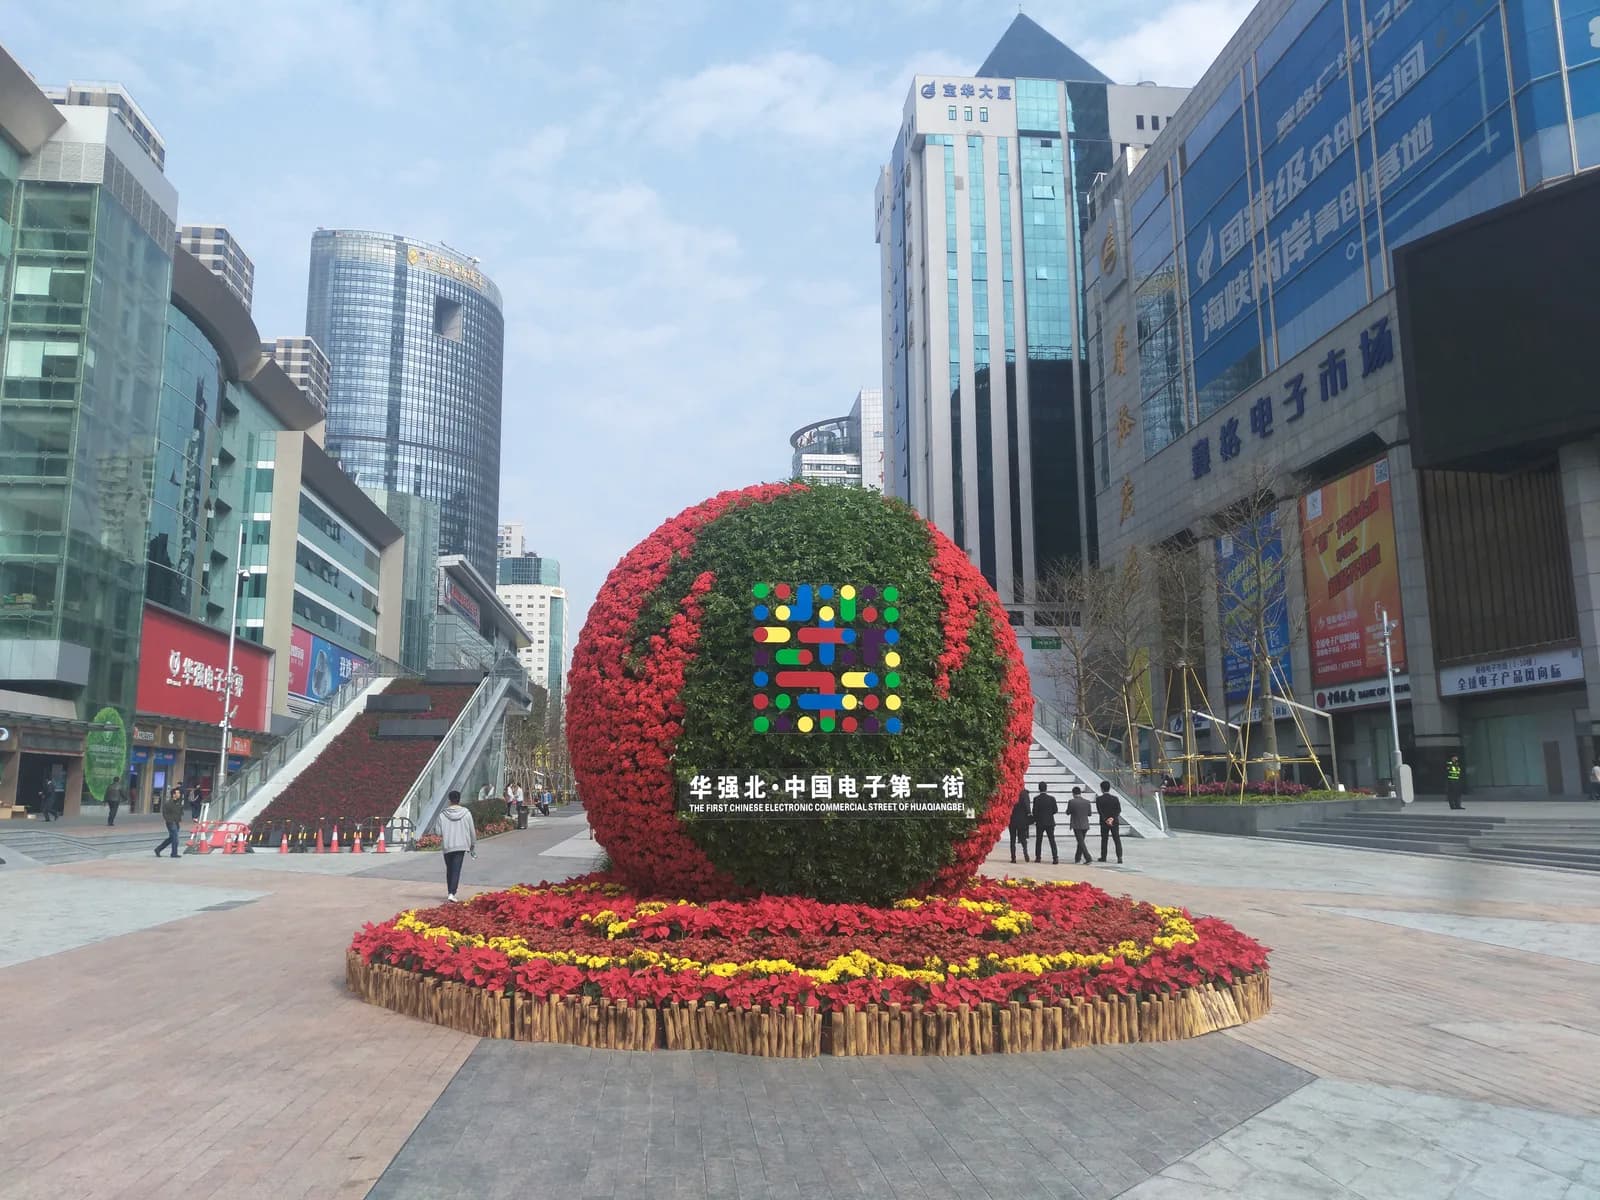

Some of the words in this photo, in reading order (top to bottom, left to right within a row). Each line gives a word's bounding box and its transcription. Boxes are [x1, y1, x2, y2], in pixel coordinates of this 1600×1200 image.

[943, 83, 1012, 100] 宝华大厦
[1219, 40, 1426, 266] 国家级众创空间
[1202, 113, 1433, 342] 海峡两岸青创基地
[182, 657, 244, 698] 华强电子世界
[689, 774, 965, 800] 华强北·中国电子第一街
[689, 804, 705, 812] THE
[706, 804, 728, 812] FIRST
[729, 803, 764, 812] CHINESE
[765, 803, 814, 812] ELECTRONIC
[815, 803, 867, 812] COMMERCIAL
[868, 803, 898, 811] STREET
[898, 803, 909, 811] OF
[910, 803, 965, 811] HUAQIANGBEI
